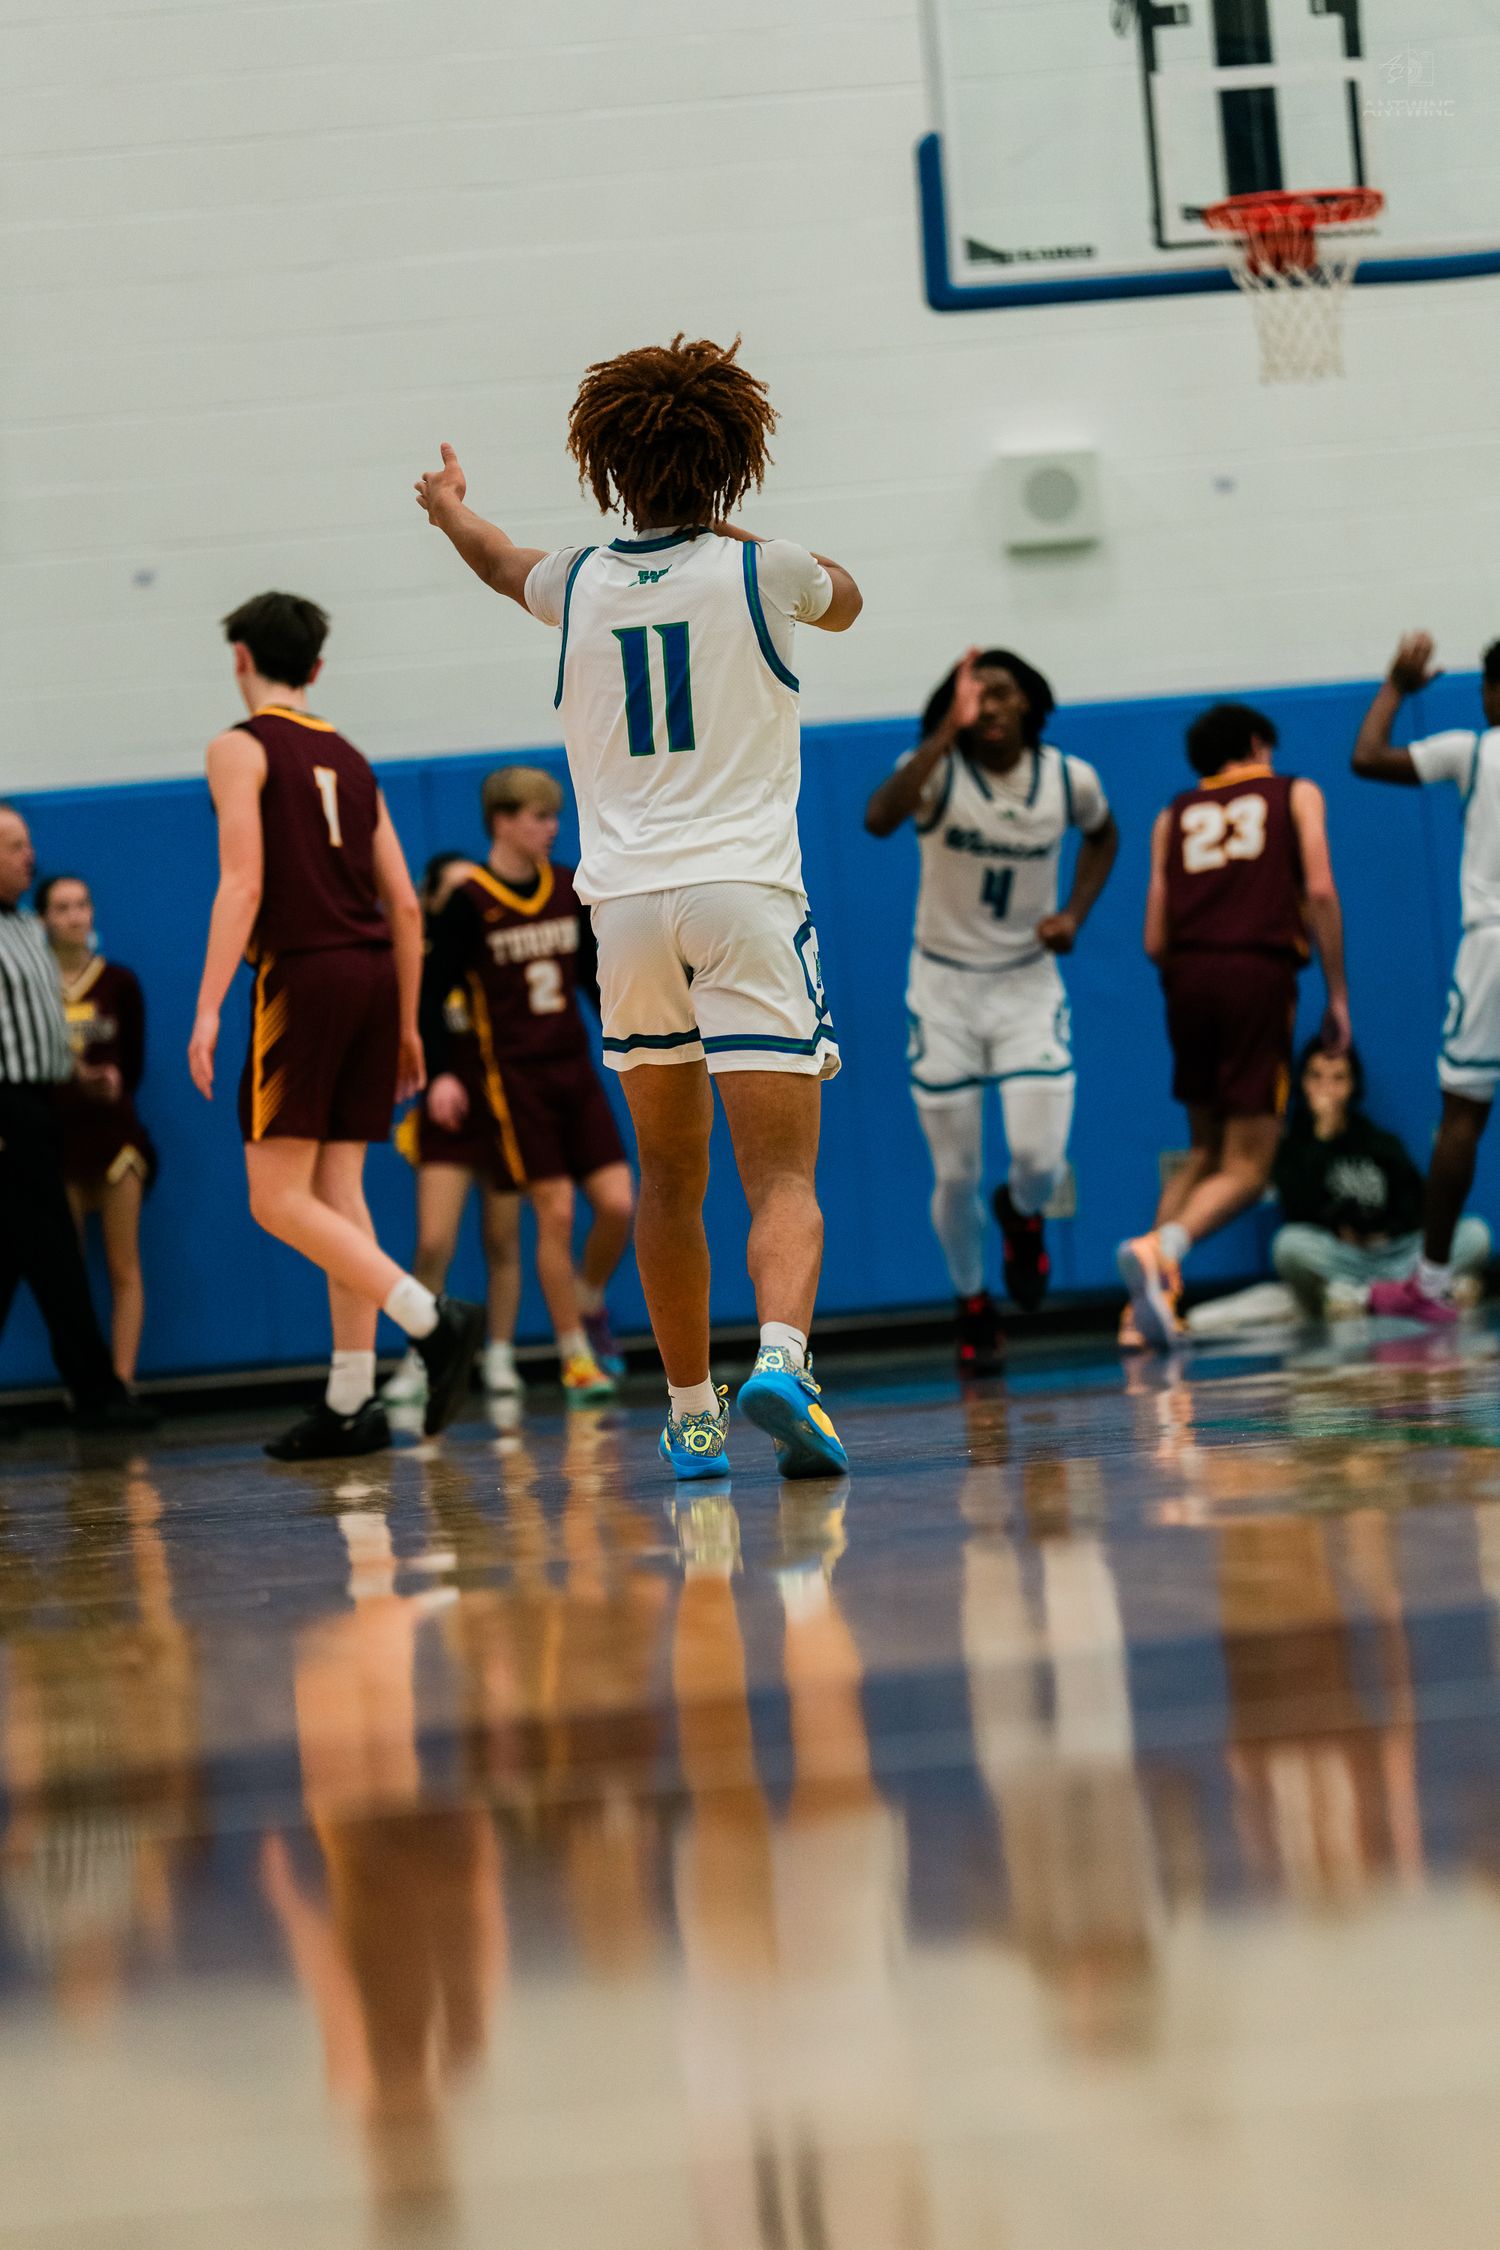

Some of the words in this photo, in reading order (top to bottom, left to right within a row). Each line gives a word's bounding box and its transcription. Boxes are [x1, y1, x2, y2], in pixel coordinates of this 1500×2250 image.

[611, 620, 696, 757] 11
[312, 765, 344, 848] 1
[1178, 793, 1268, 874] 23
[981, 865, 1014, 919] 4
[524, 960, 567, 1015] 2
